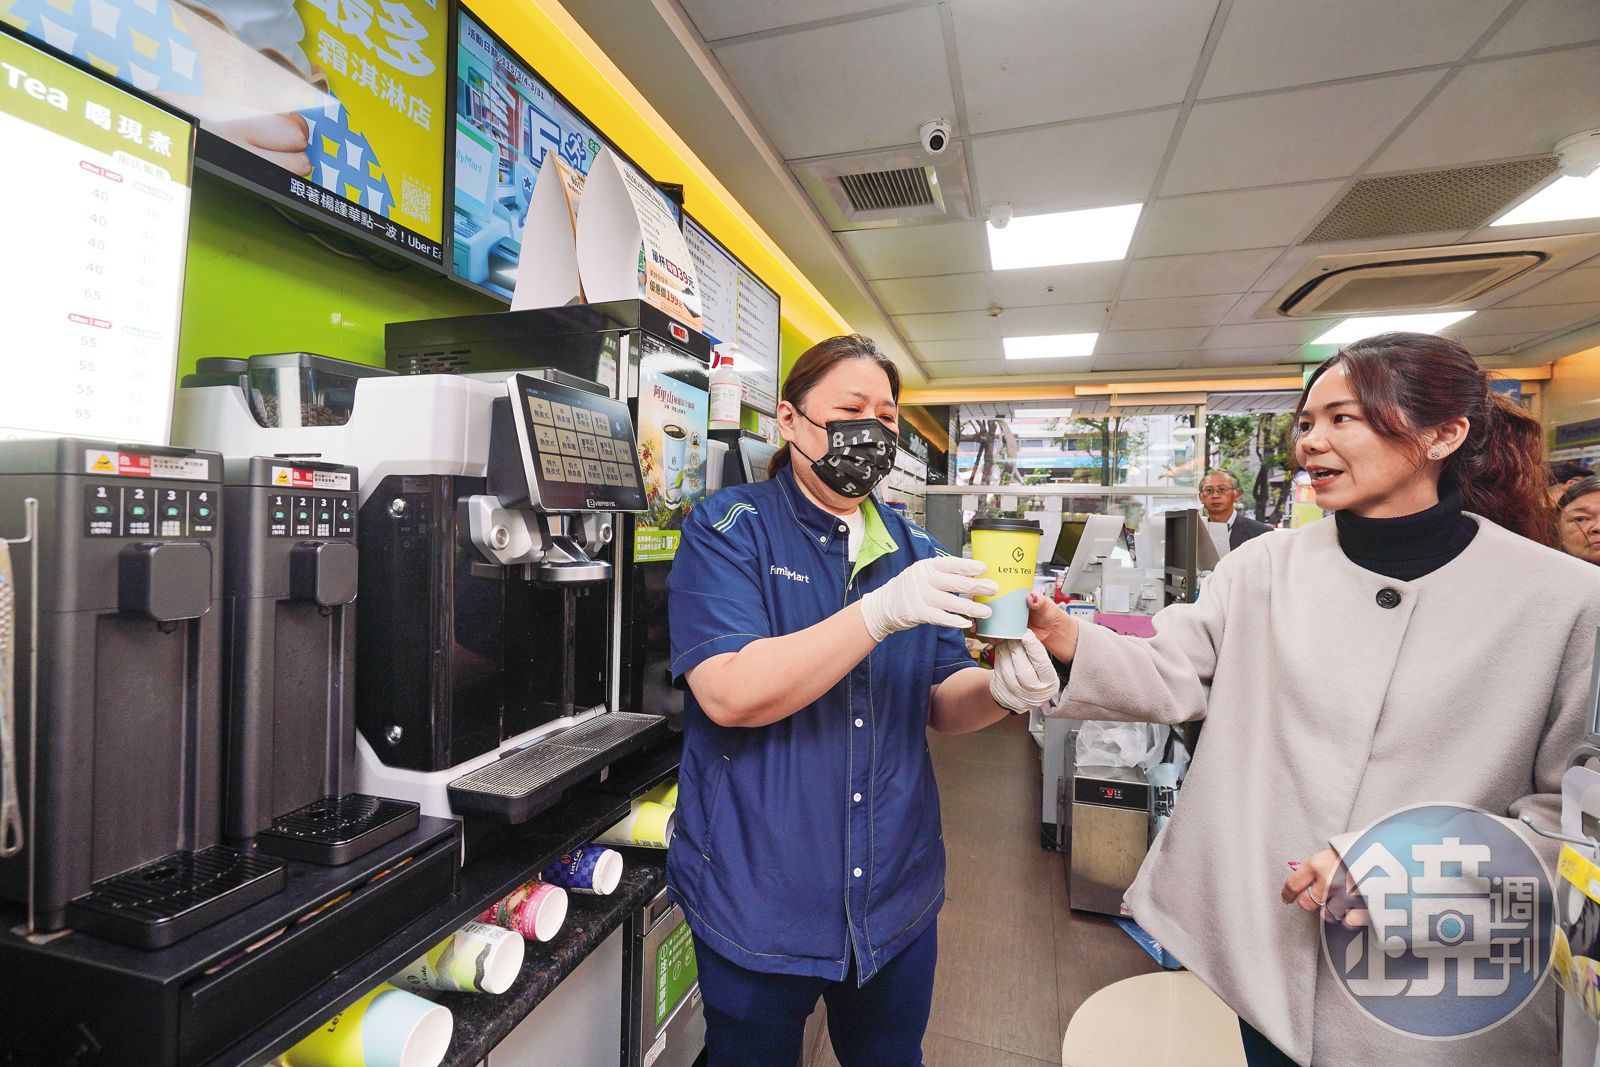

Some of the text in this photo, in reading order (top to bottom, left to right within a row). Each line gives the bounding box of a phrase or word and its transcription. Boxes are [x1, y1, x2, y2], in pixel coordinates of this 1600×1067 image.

[1, 62, 69, 111] Tea
[317, 29, 432, 131] 霜淇淋店
[92, 188, 109, 202] 40
[90, 213, 107, 227] 40
[88, 238, 105, 251] 40
[408, 235, 430, 254] Uber
[86, 262, 103, 275] 40
[833, 431, 845, 448] 8
[861, 429, 873, 443] 2
[876, 440, 887, 456] 9
[97, 487, 107, 498] 1
[134, 488, 144, 499] 2
[167, 490, 176, 500] 3
[199, 491, 208, 502] 4
[275, 496, 282, 505] 1
[299, 497, 306, 506] 2
[321, 499, 327, 507] 3
[341, 500, 348, 508] 4
[998, 566, 1019, 574] Let's
